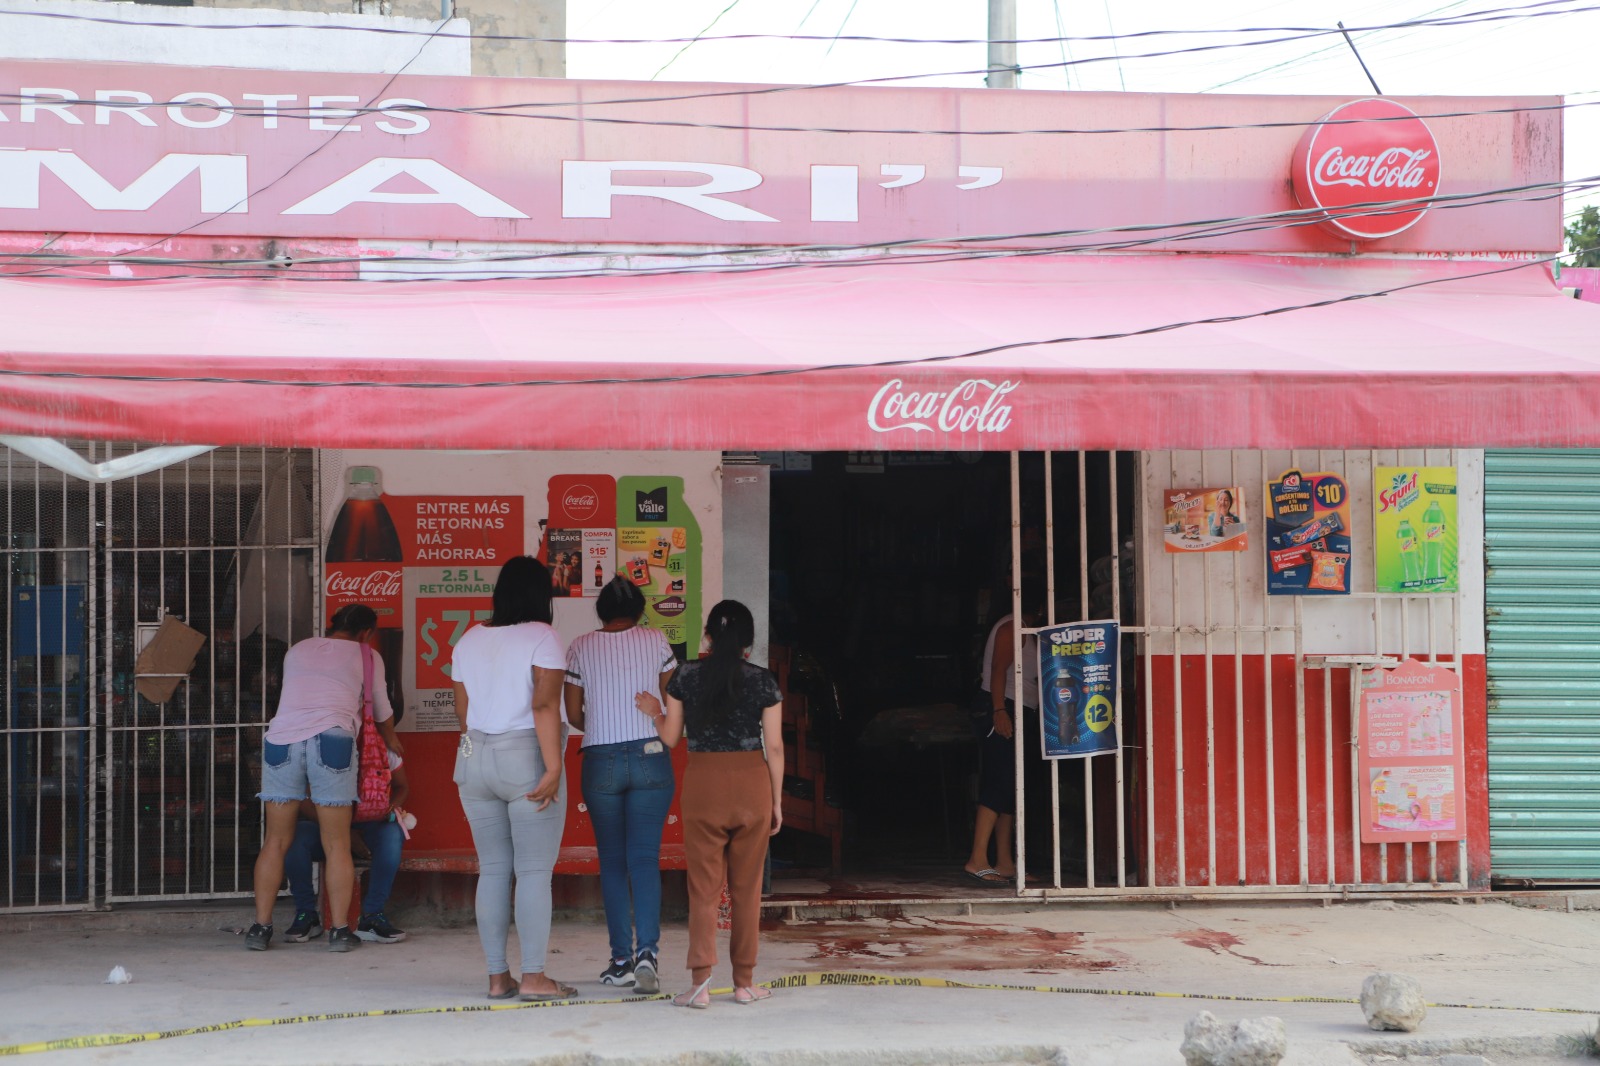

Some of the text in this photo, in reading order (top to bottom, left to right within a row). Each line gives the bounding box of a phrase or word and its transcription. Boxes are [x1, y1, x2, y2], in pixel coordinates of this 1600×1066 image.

[0, 87, 431, 135] RROTES
[1314, 146, 1432, 188] Coca-Cola
[867, 379, 1020, 433] Coca-Cola
[1379, 472, 1418, 513] Squirt
[416, 500, 510, 514] ENTRE MÁS
[565, 495, 595, 506] Coca-Cola
[416, 517, 505, 529] RETORNAS
[416, 531, 453, 544] MÁS
[416, 548, 496, 560] AHORRAS
[442, 569, 484, 581] 2.5 L
[326, 570, 404, 597] Coca-Cola
[1050, 628, 1105, 645] SÚPER
[1386, 674, 1436, 685] BONAFONT
[434, 691, 454, 699] OFE
